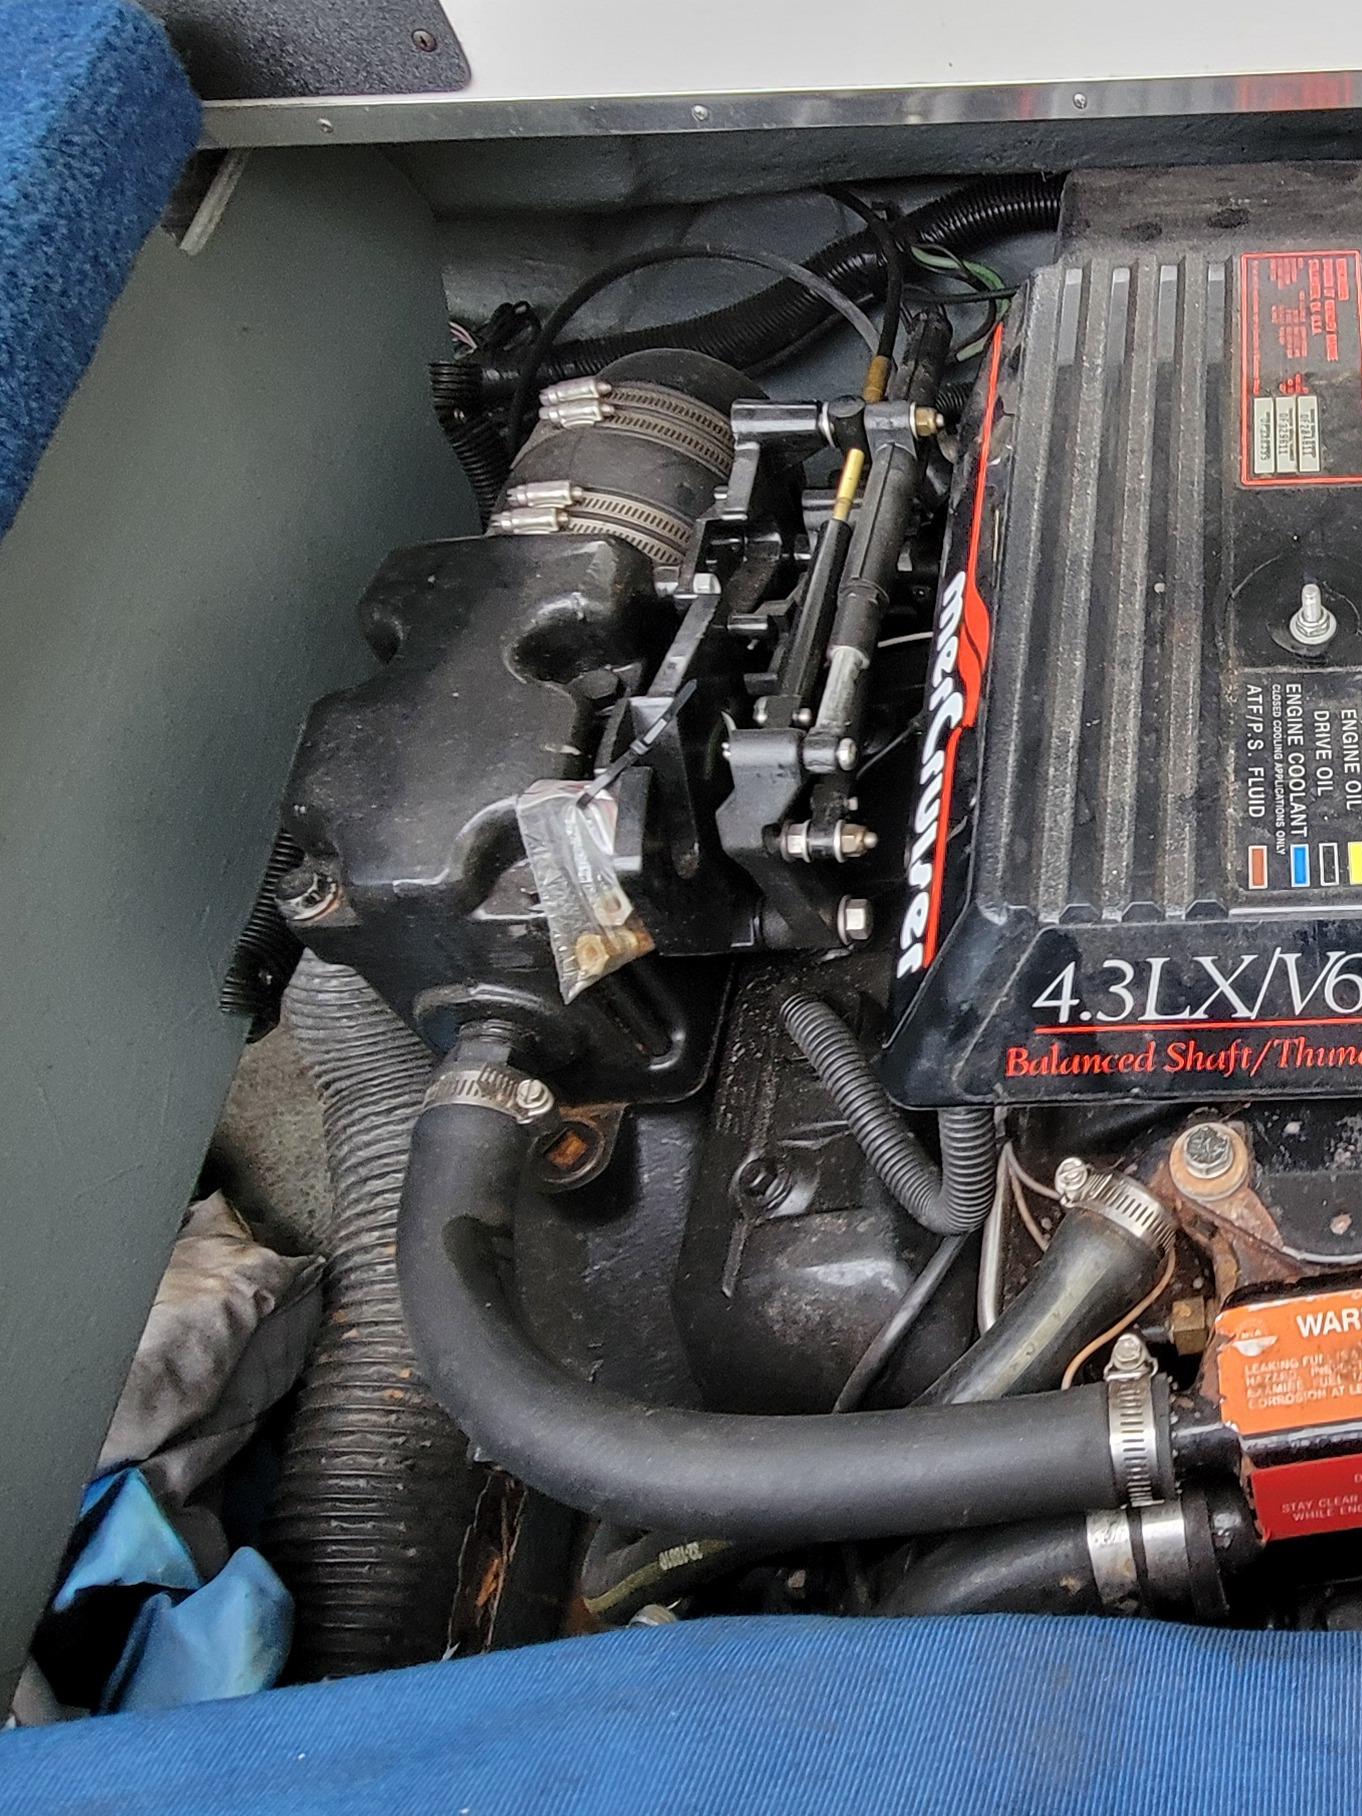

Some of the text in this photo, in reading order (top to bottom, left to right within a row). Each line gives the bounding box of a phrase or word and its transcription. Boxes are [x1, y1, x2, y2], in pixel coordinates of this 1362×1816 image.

[1246, 684, 1265, 818] ATF/P.S. FLUID
[1272, 684, 1286, 856] CLOSED COOLING APPLICATIONS ONLY
[1286, 683, 1308, 838] ENGINE COOLANT
[1314, 710, 1334, 796] DRIVE OIL
[1341, 708, 1362, 811] ENGINE OIL
[1005, 1041, 1157, 1078] Balanced
[1244, 1358, 1299, 1374] LEAKING
[1331, 1385, 1345, 1397] AT
[1282, 1501, 1312, 1513] STAY
[1318, 1493, 1359, 1508] CLEAR
[1292, 1506, 1332, 1522] WHILE
